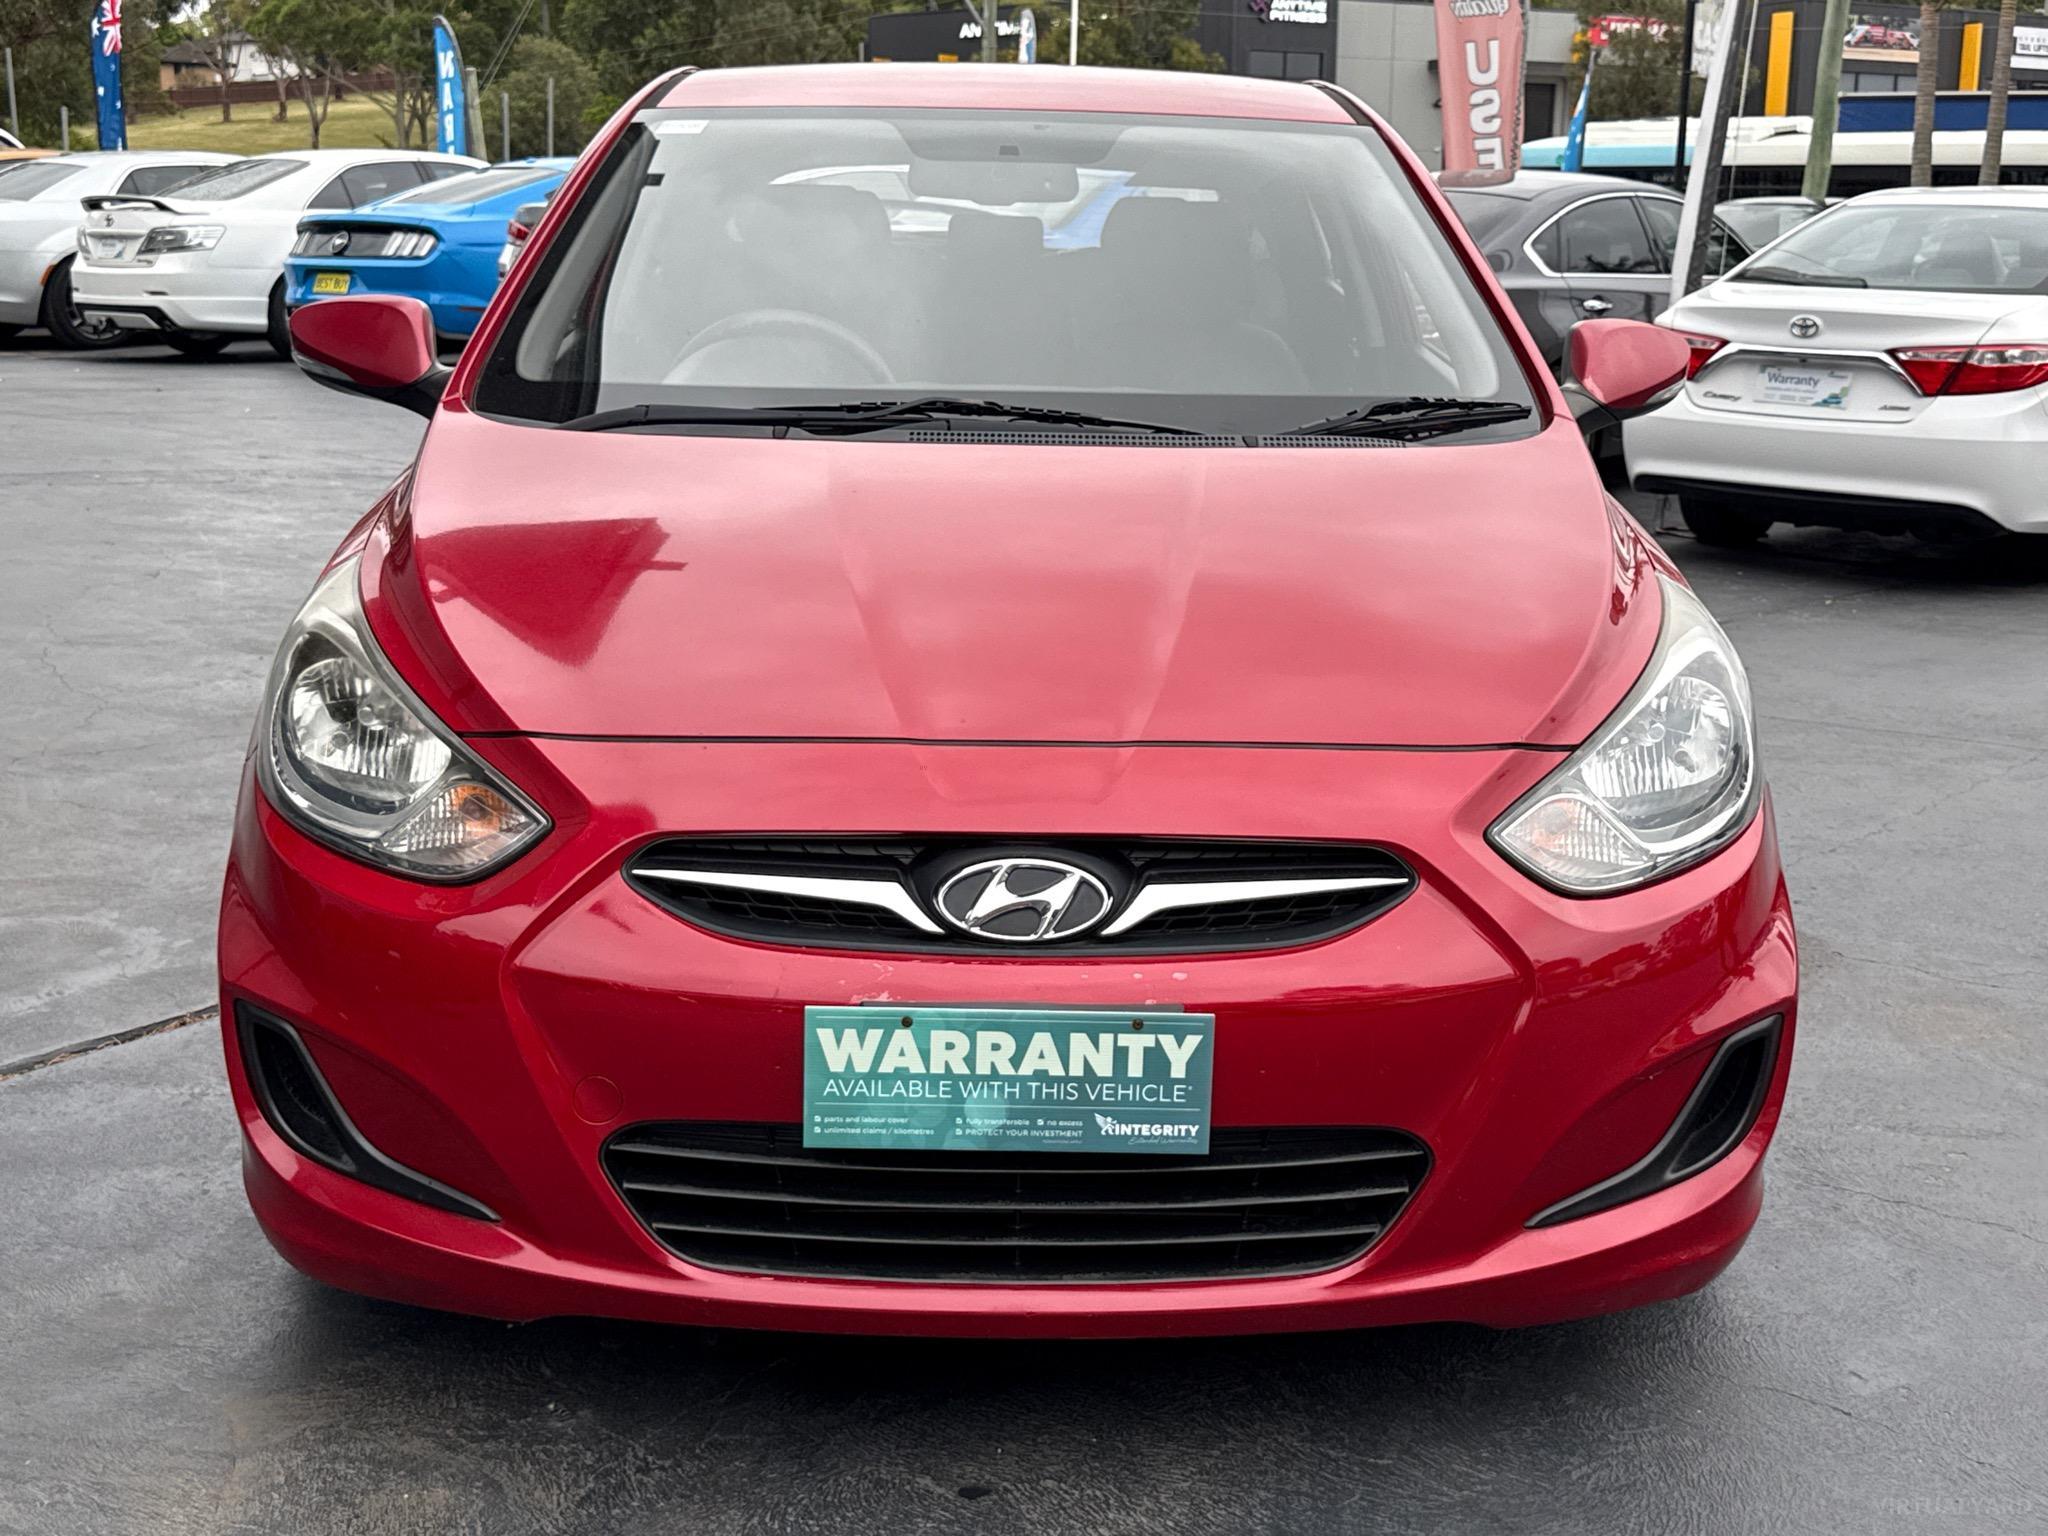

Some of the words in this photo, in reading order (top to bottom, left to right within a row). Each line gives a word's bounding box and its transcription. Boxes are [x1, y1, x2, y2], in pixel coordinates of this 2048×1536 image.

[1267, 10, 1328, 24] FITNESS
[1767, 371, 1820, 389] Warranty
[816, 1027, 1203, 1078] WARRANTY
[823, 1079, 952, 1098] AVAILABLE
[959, 1081, 1020, 1099] WITH
[1027, 1082, 1078, 1101] THIS
[824, 1115, 844, 1124] parts
[845, 1115, 860, 1123] and
[861, 1116, 887, 1124] labour
[966, 1117, 983, 1126] fully
[824, 1126, 861, 1134] unlimited
[862, 1126, 887, 1134] claims
[965, 1128, 1003, 1136] PROTECT
[1005, 1129, 1029, 1137] YOUR
[1030, 1129, 1083, 1137] INVESTMENT
[1115, 1123, 1200, 1136] INTEGRITY
